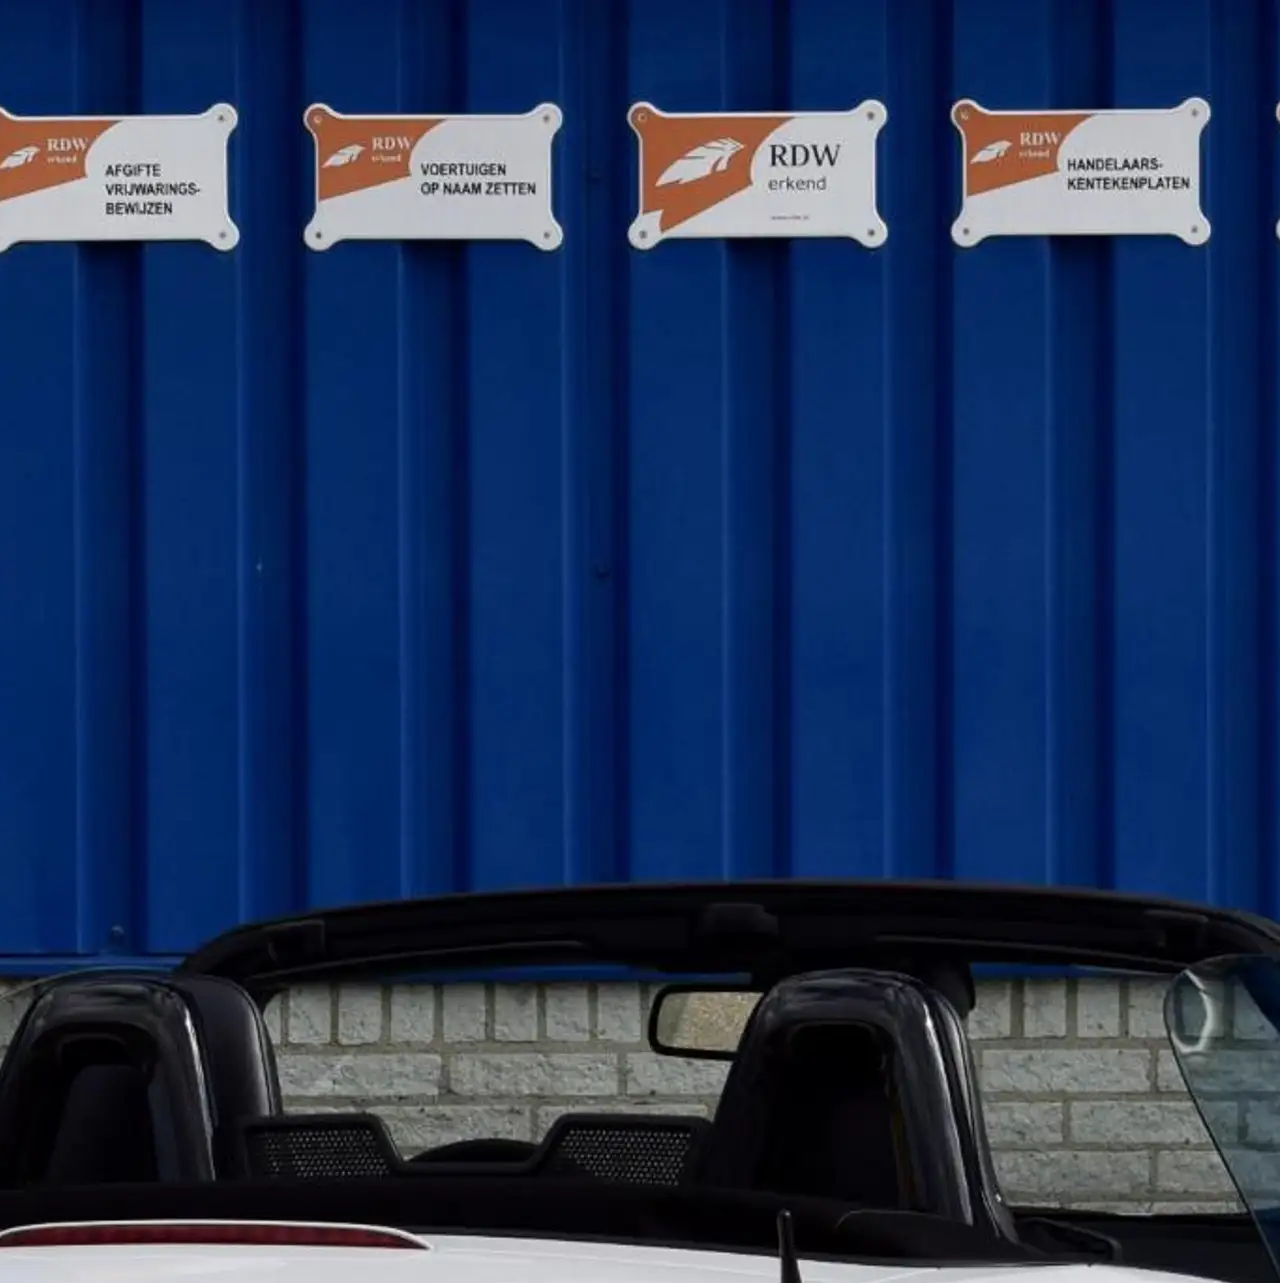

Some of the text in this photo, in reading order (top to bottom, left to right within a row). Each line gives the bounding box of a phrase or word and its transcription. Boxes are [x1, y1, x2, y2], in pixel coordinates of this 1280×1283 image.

[47, 138, 88, 152] RDW
[372, 136, 412, 151] RDW
[1020, 131, 1062, 146] RDW
[769, 143, 841, 167] RDW
[105, 164, 161, 177] AFGIFTE
[420, 163, 507, 176] VOERTUIGEN
[1067, 158, 1163, 171] HANDELAARS-
[105, 183, 200, 196] VRIJWARINGS-
[420, 181, 537, 195] OP NAAM ZETTEN
[768, 176, 827, 191] erkend
[1067, 177, 1190, 190] KENTEKENPLATEN
[105, 202, 173, 215] BEWIJZEN
